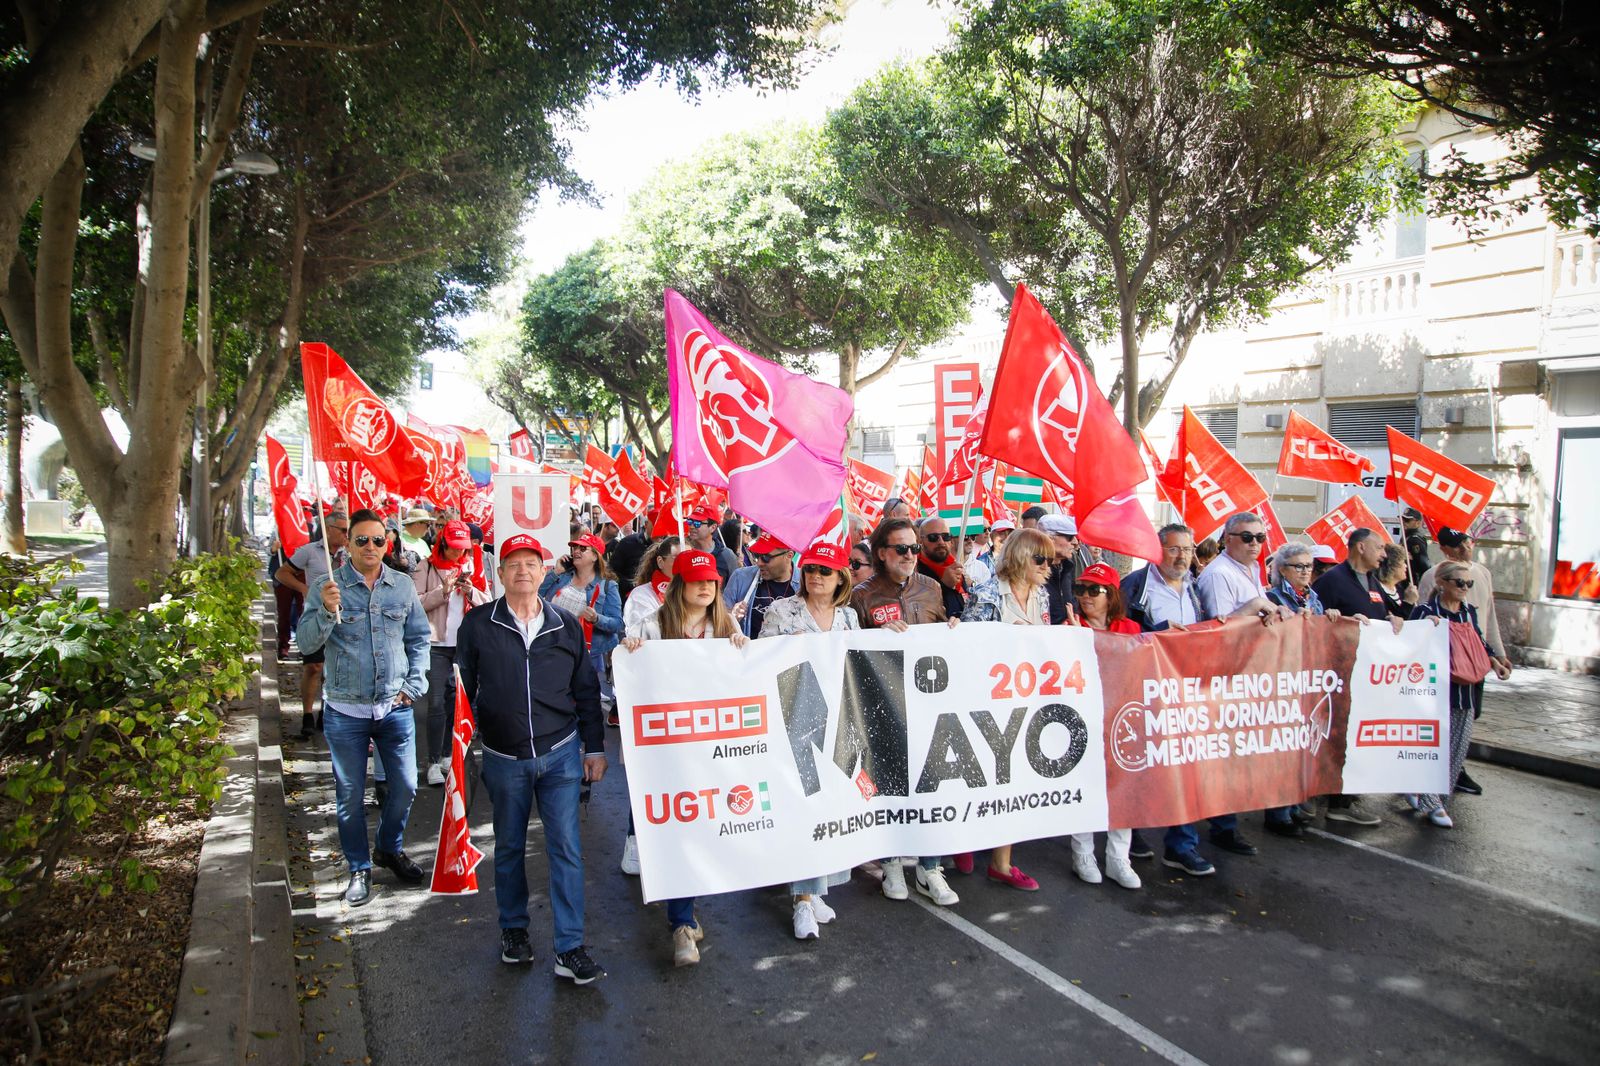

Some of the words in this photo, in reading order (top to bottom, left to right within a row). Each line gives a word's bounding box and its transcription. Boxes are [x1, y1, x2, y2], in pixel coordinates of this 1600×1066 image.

[1185, 452, 1237, 521] COO
[691, 556, 705, 564] UGT
[988, 660, 1086, 700] 2024
[1143, 678, 1180, 706] POR
[1183, 677, 1206, 702] EL
[1210, 672, 1273, 700] PLENO
[1369, 663, 1407, 686] UGT
[1399, 685, 1437, 697] Almería
[641, 706, 740, 738] CCOO
[1145, 705, 1210, 737] MENOS
[1214, 698, 1305, 730] JORNADA,
[1359, 724, 1418, 743] CCOO
[712, 740, 768, 760] Almería
[1146, 732, 1231, 768] MEJORES
[1234, 723, 1311, 757] SALARIO
[1397, 750, 1439, 761] Almería
[645, 787, 720, 825] UGT
[812, 805, 957, 842] #PLENOEMPLEO
[962, 801, 972, 823] /
[976, 788, 1083, 818] #1MAYO2024
[719, 816, 774, 837] Almería
